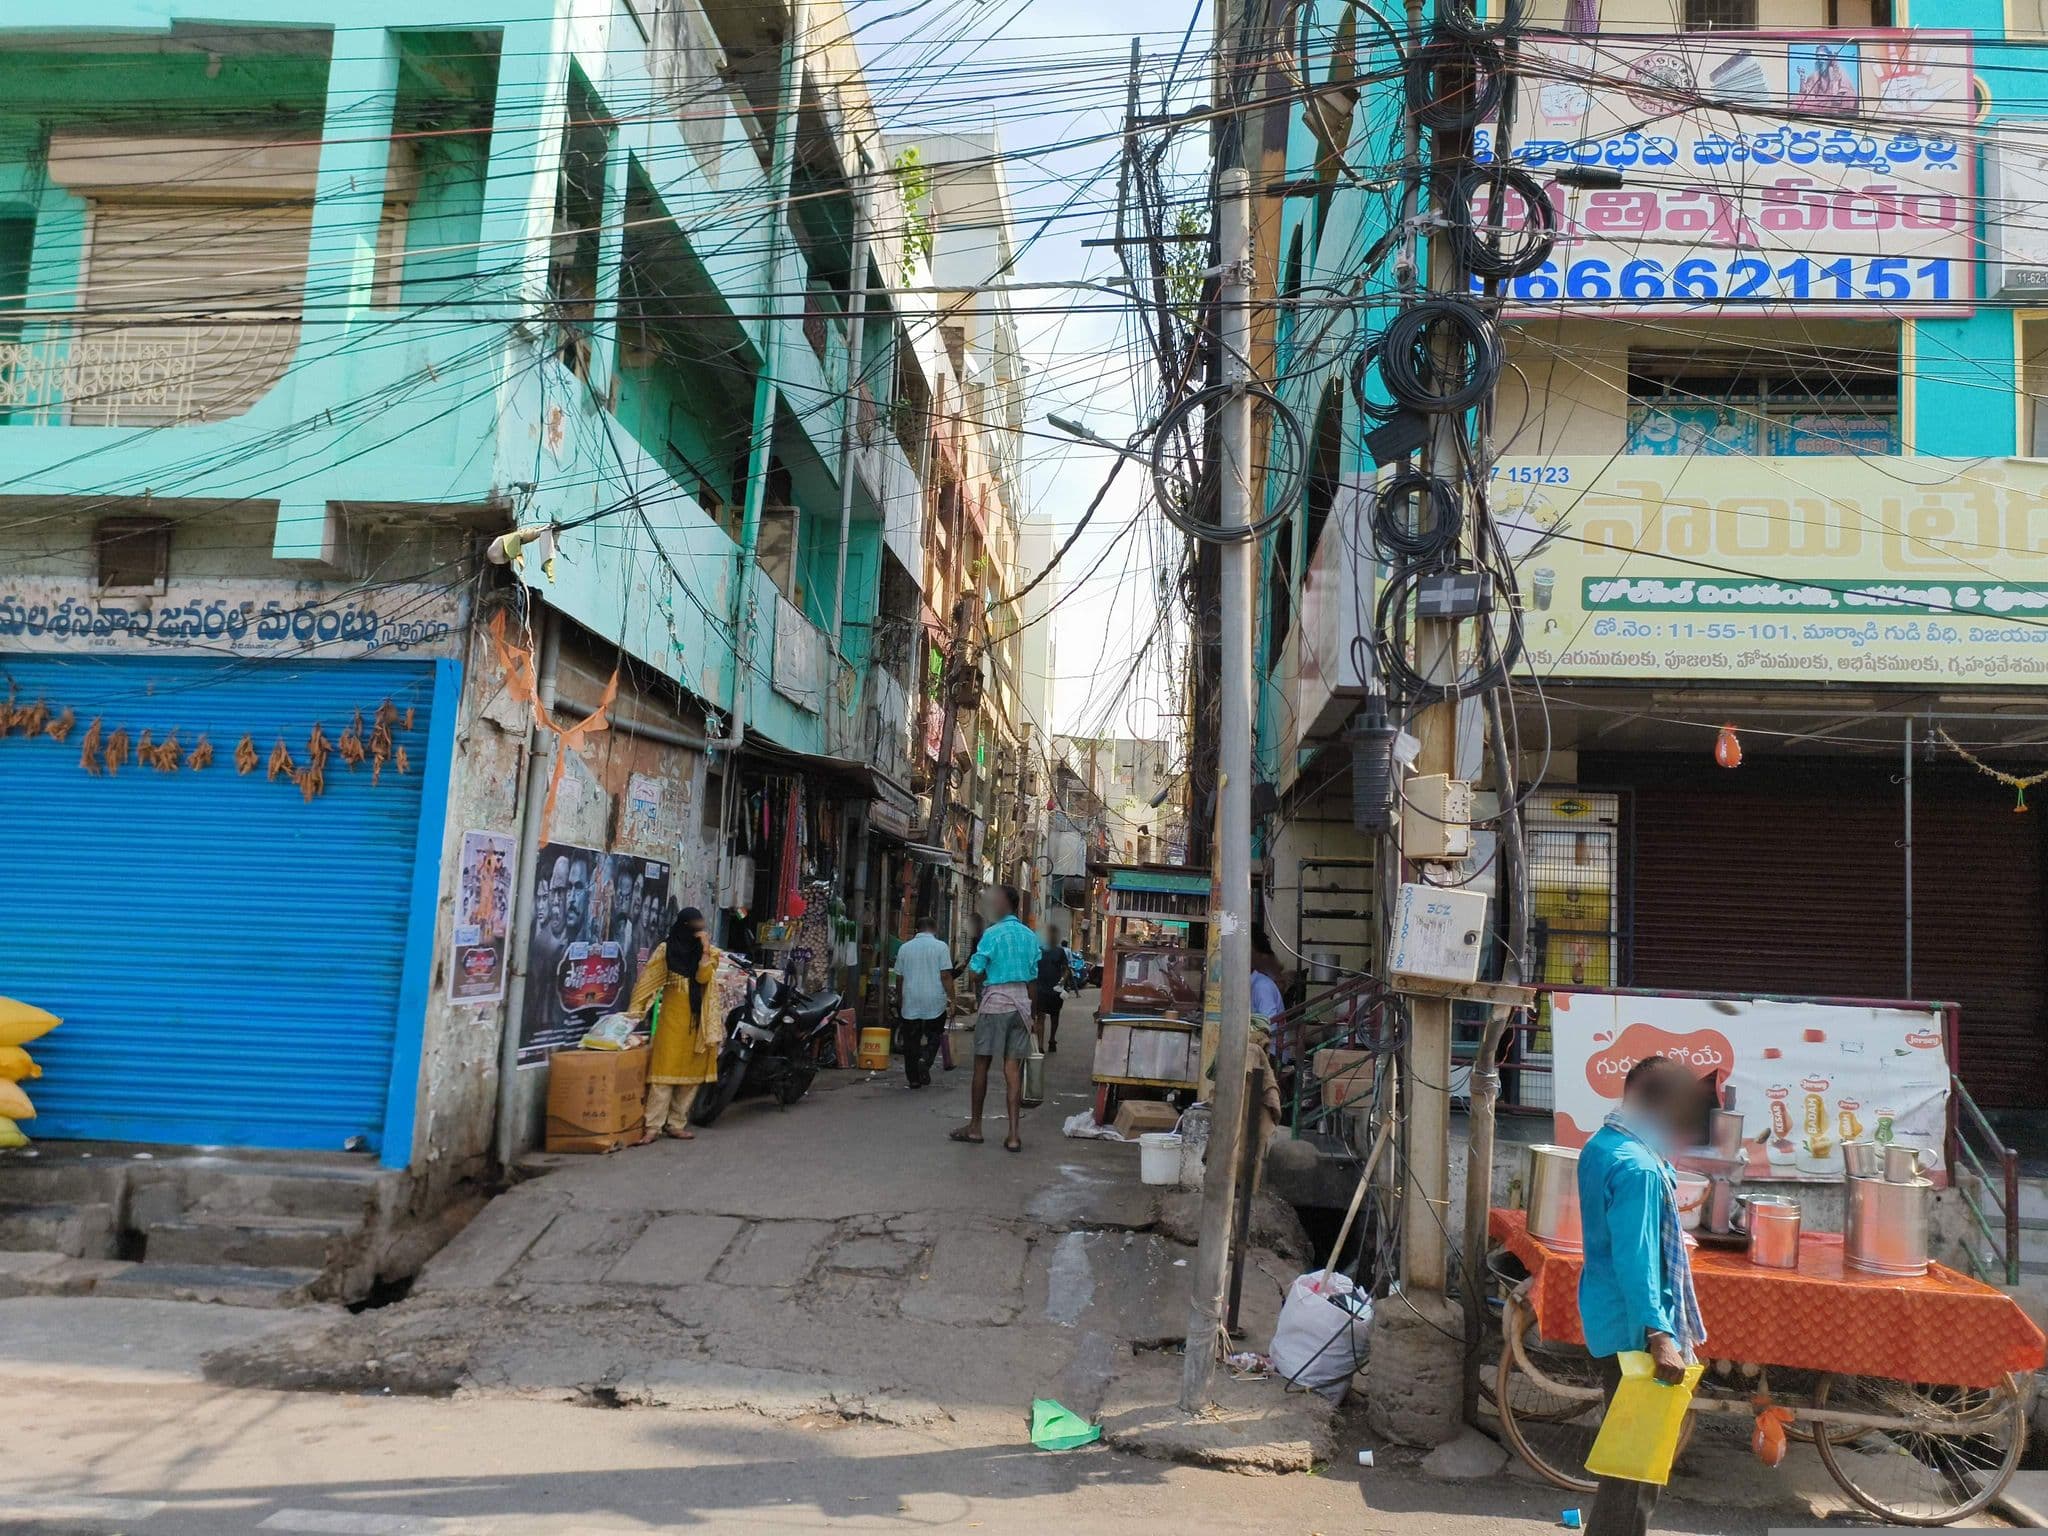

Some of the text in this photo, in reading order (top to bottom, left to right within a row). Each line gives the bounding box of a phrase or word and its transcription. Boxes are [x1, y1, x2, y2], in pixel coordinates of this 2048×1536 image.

[1760, 178, 1957, 231] పీఠం
[1884, 621, 1921, 642] గుడి
[1773, 1105, 1784, 1133] KESAR
[1808, 1097, 1819, 1137] BADAM
